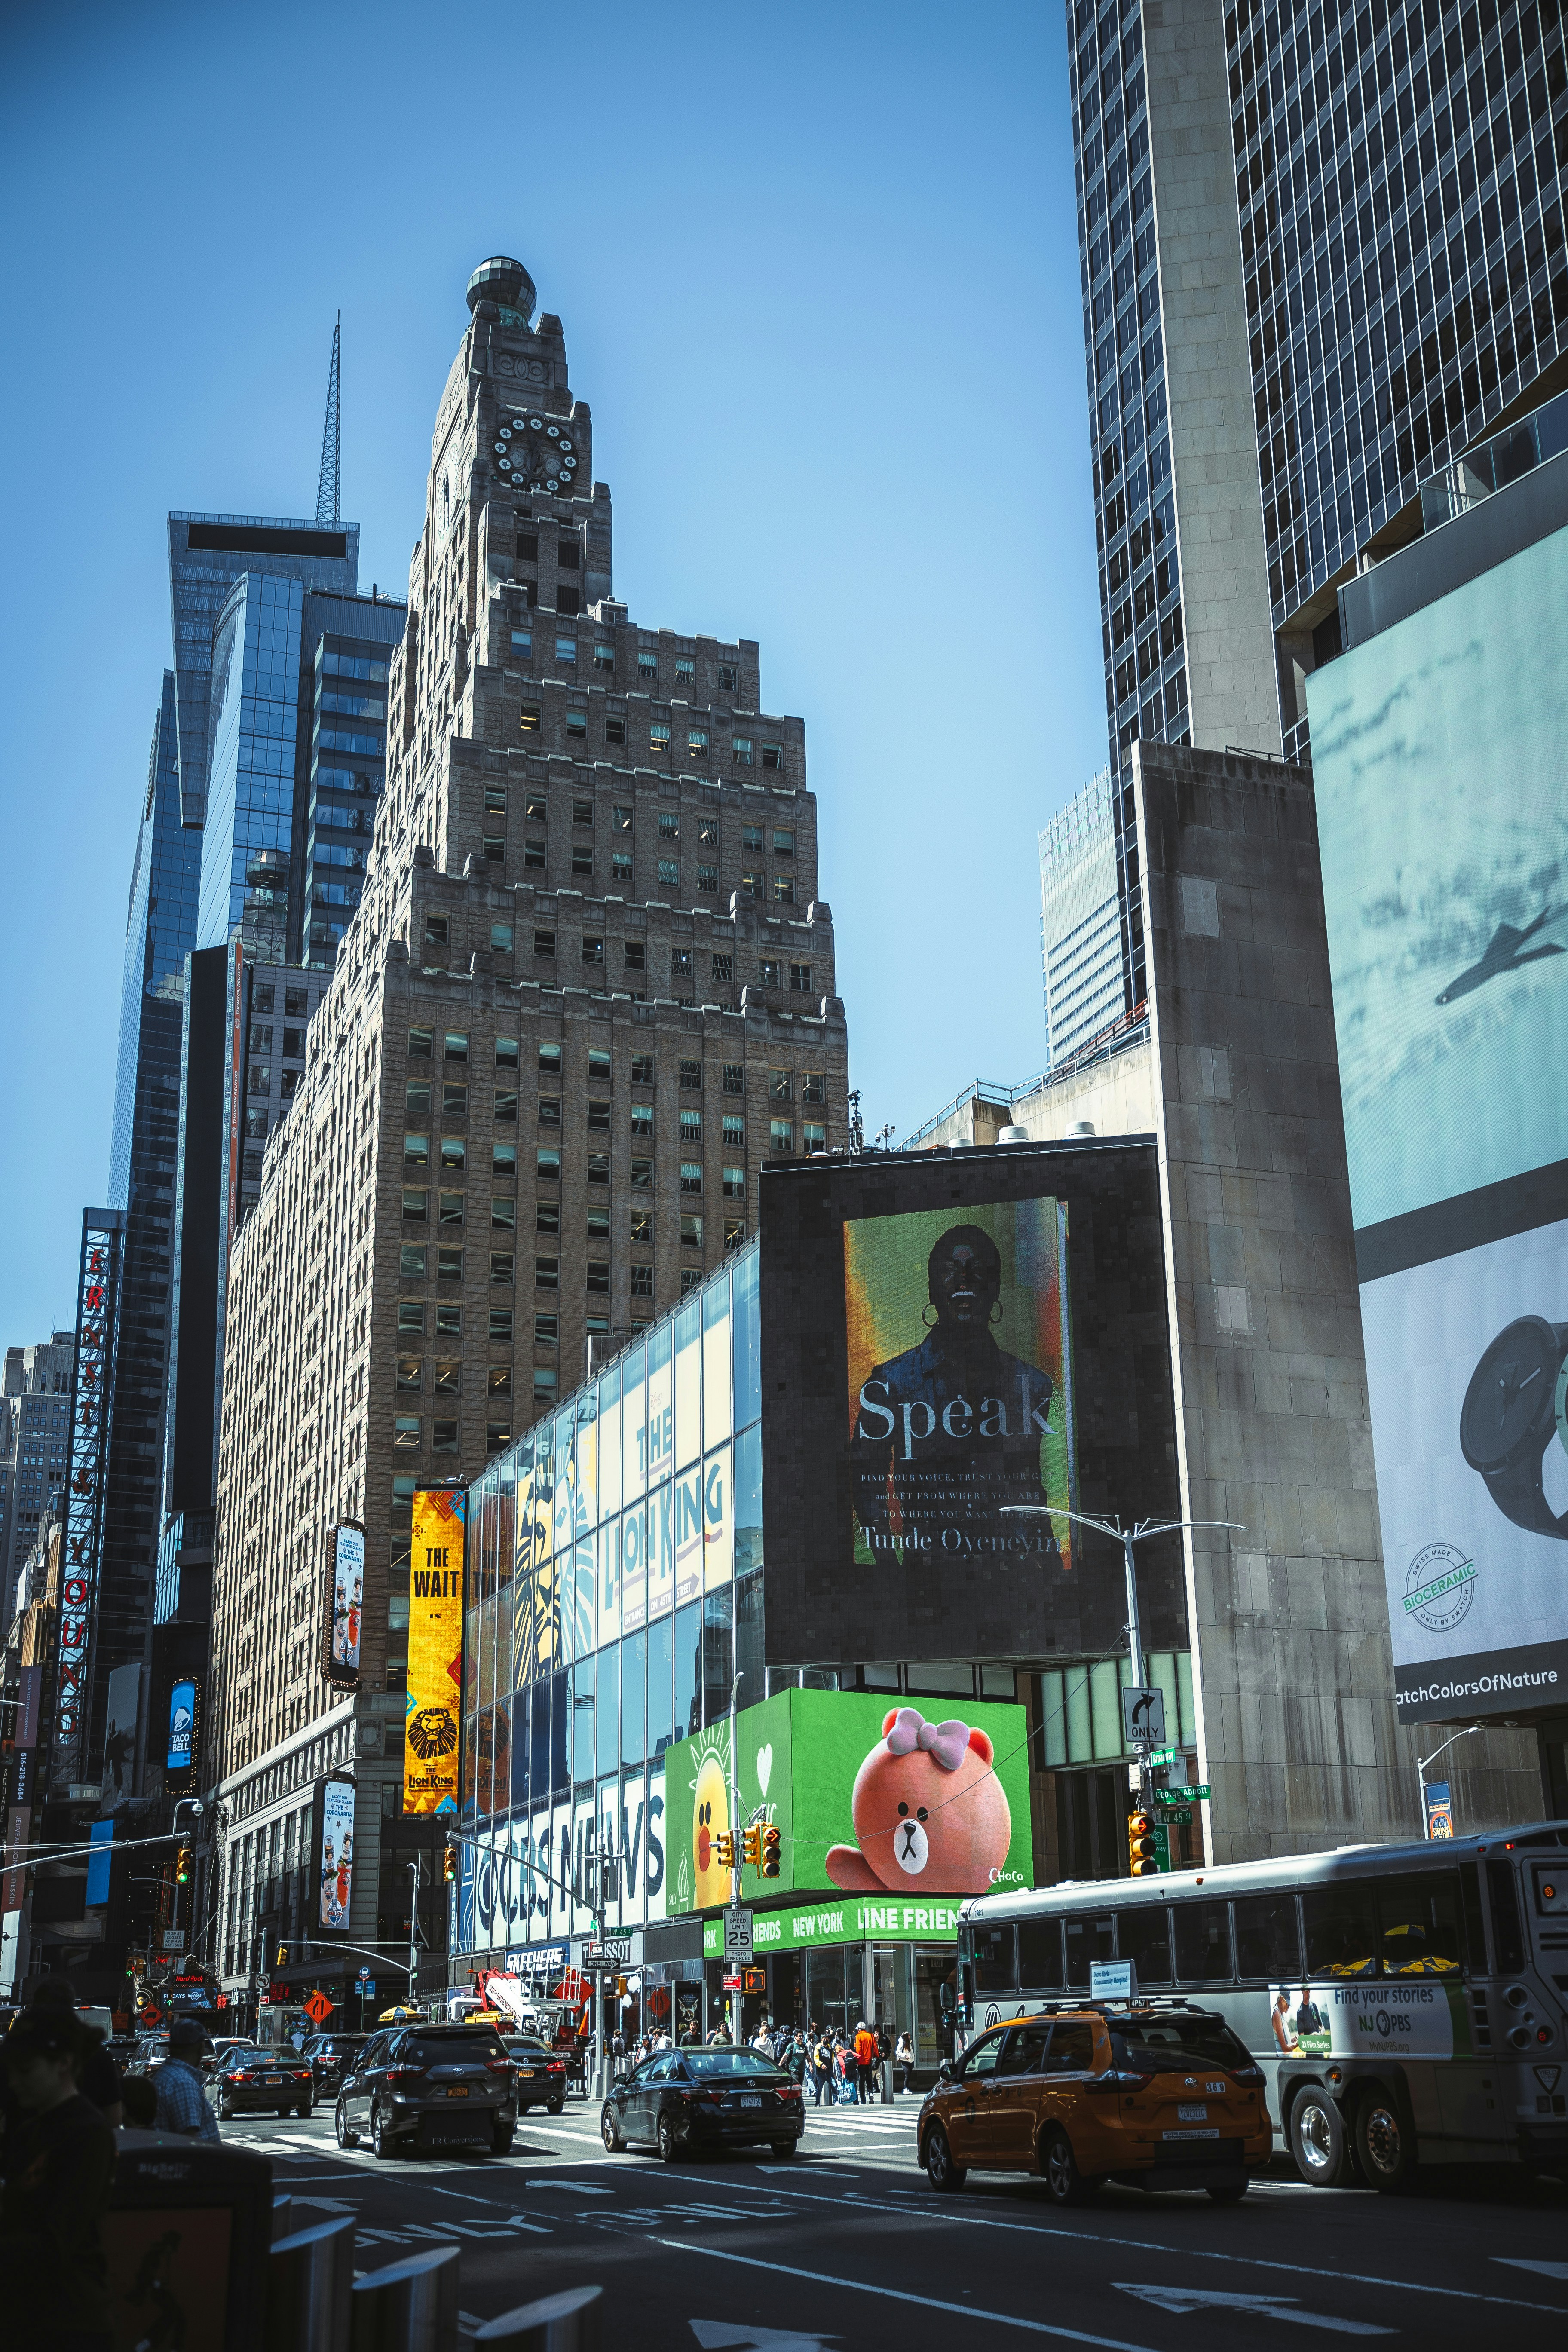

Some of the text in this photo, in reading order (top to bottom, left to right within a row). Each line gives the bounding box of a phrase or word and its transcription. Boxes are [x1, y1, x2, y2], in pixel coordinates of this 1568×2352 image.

[80, 1249, 104, 1424] ERNST
[859, 1374, 1059, 1459] Speak
[636, 1406, 672, 1474] THE
[861, 1473, 1026, 1482] FIND YOUR VOICE, TRUST YOUR
[991, 1491, 1011, 1500] YOU
[1018, 1491, 1040, 1500] ARE
[965, 1510, 995, 1519] WANT
[598, 1503, 655, 1611] LION
[659, 1463, 723, 1580] KING
[859, 1526, 1062, 1560] Tunde Oyeneyin
[339, 1552, 362, 1563] CORONARITA
[426, 1548, 449, 1567] THE
[1413, 1553, 1429, 1575] SWISS
[413, 1571, 460, 1598] WAIT
[1403, 1563, 1476, 1611] BIOCERAMIC
[625, 1580, 691, 1626] ENTRANCE ON 45TH STREET
[1421, 1613, 1437, 1625] ONLY
[1452, 1589, 1469, 1620] SWATCH
[58, 1537, 86, 1733] YOUNG
[172, 1733, 190, 1743] TACO
[1131, 1727, 1159, 1738] ONLY
[172, 1742, 189, 1752] BELL
[1153, 1750, 1174, 1764] Broadway
[17, 1752, 27, 1800] 516-218-3614
[409, 1774, 453, 1788] LION KING
[1156, 1786, 1207, 1798] George Abbott
[326, 1809, 352, 1818] CORONARITA
[1163, 1813, 1170, 1822] W
[1174, 1813, 1183, 1823] 45
[499, 1795, 665, 1924] CBS NEWS
[753, 1908, 958, 1942] RIENDS NEW YORK LINE FRIEN
[728, 1931, 750, 1946] 25
[506, 1947, 564, 1974] SKECHERS
[1113, 1976, 1127, 1984] Hospital
[1335, 1983, 1434, 2009] Find your stories
[1359, 2014, 1411, 2032] NJ PBS
[1307, 2040, 1317, 2049] Film
[1317, 2040, 1330, 2050] Series
[1370, 2040, 1410, 2054] MyNJPBS.org
[444, 2136, 484, 2144] Conversions
